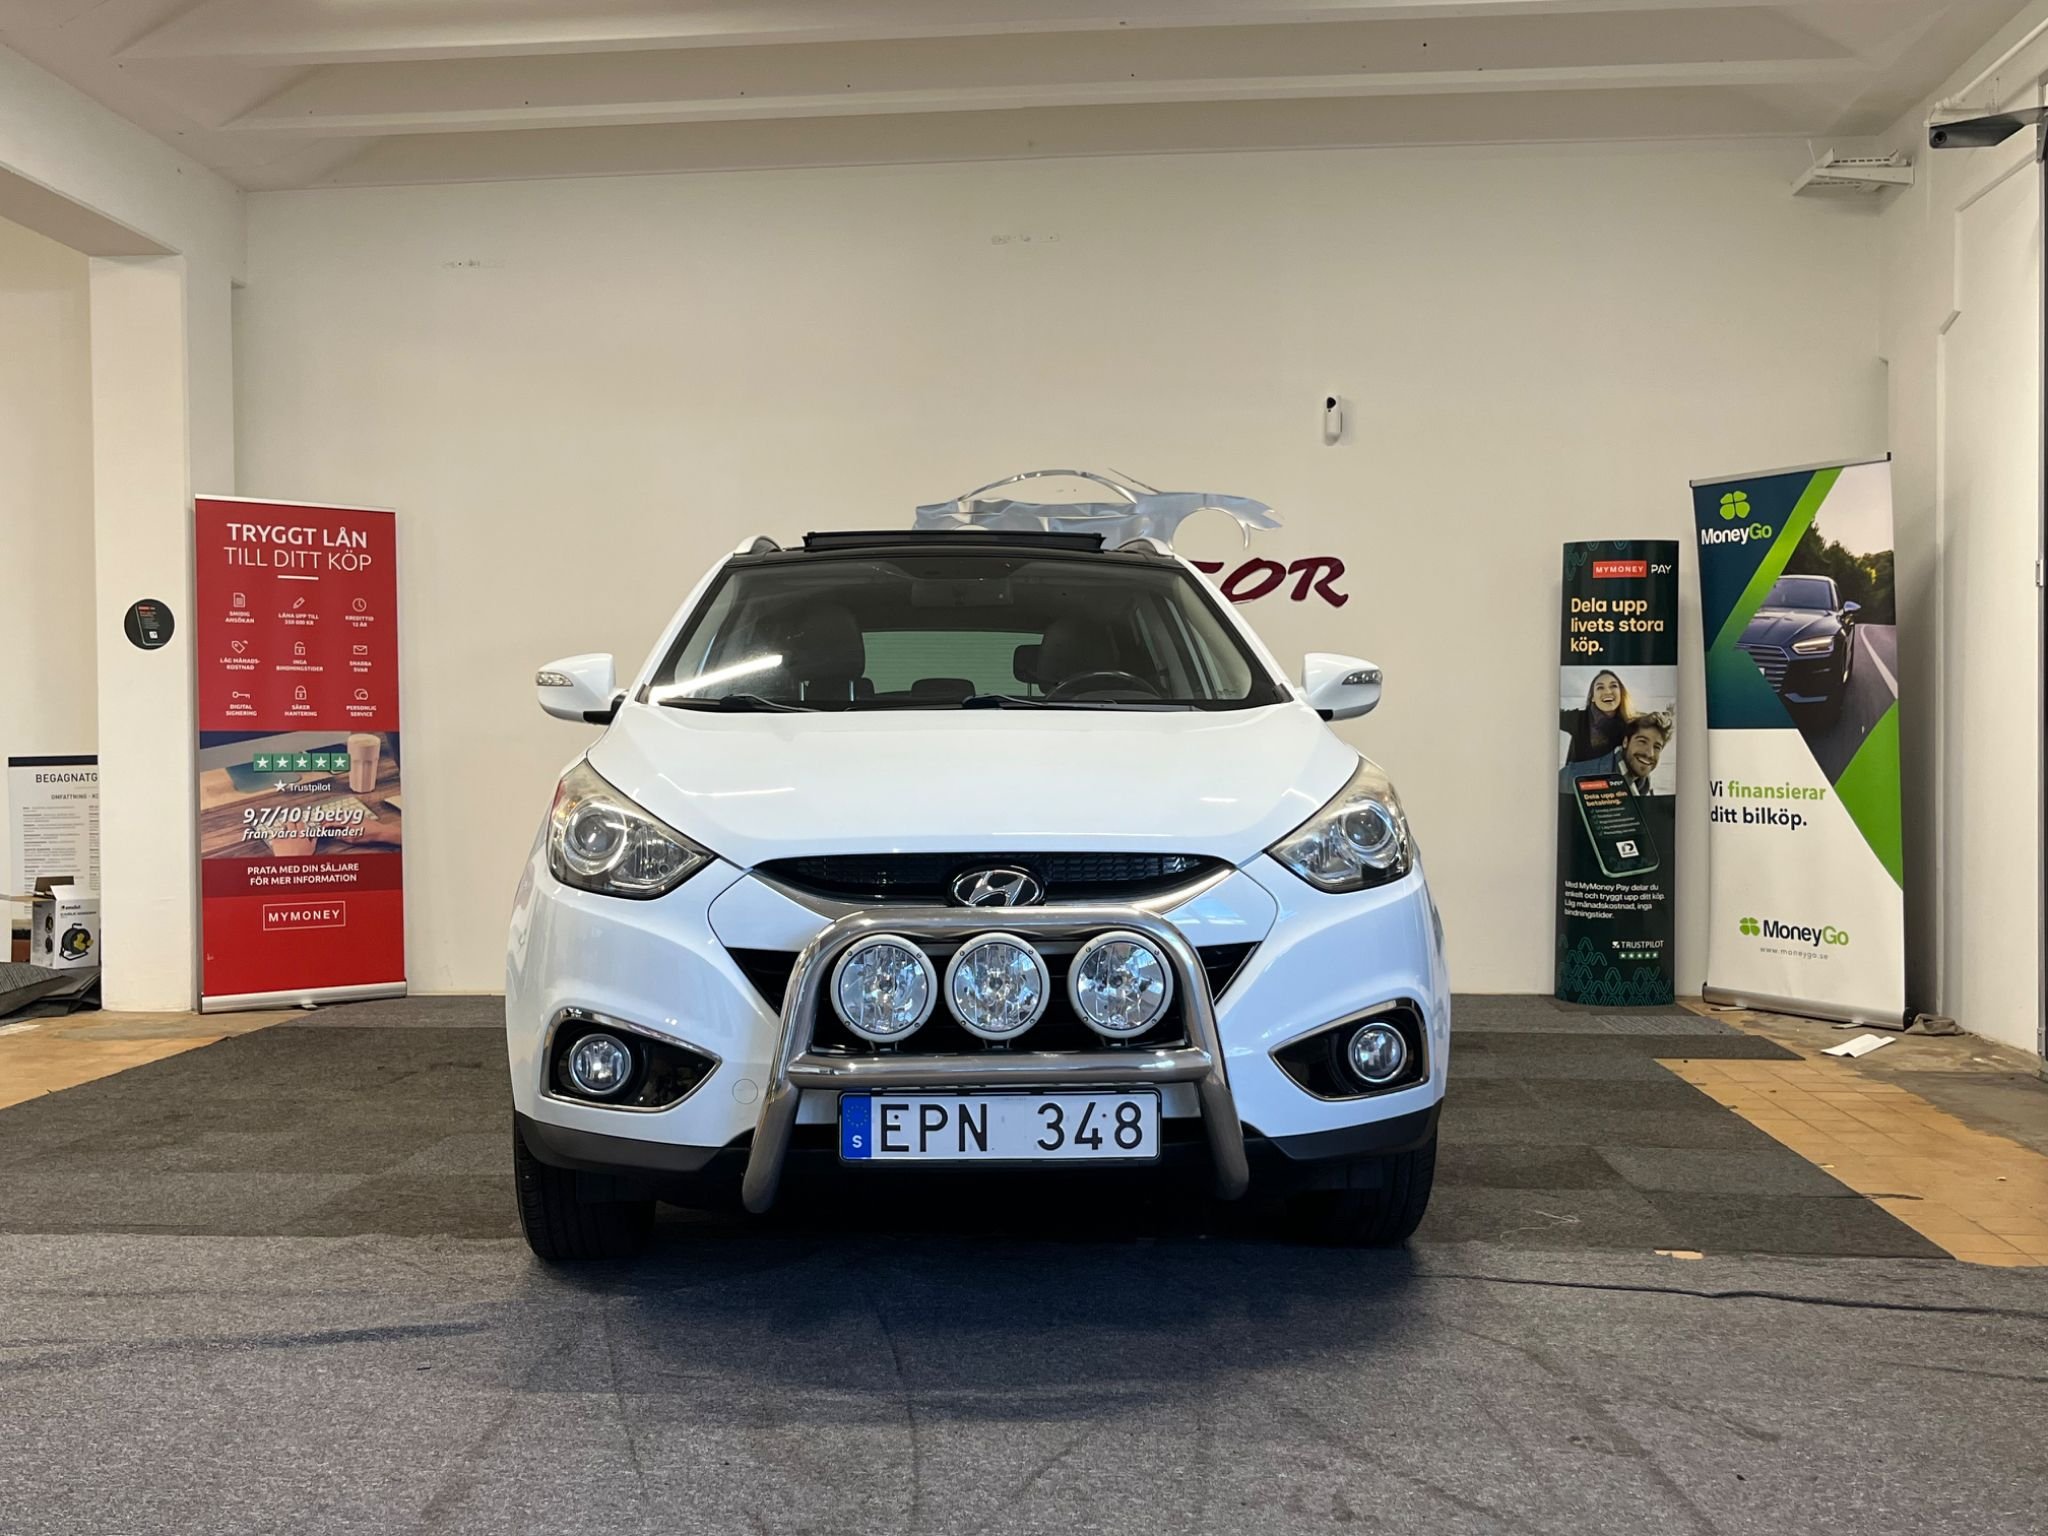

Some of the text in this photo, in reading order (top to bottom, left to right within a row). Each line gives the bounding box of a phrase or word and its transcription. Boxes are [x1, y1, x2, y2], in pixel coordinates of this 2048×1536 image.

[226, 523, 368, 548] TRYGGT LÅN
[1701, 522, 1772, 545] MoneyGo
[224, 546, 372, 572] TILL DITT KÖP
[1650, 564, 1672, 574] PAY
[1571, 598, 1648, 616] Dela upp
[1571, 617, 1664, 632] livets stora
[1571, 637, 1603, 655] köp.
[290, 783, 331, 793] Trustpilot
[1709, 780, 1826, 800] Vi finansierar
[243, 806, 364, 826] 9,7/10 i betyg
[1710, 806, 1808, 830] ditt bilköp.
[299, 827, 364, 838] slutkunder!
[247, 862, 360, 875] PRATA MED DIN SÄLJARE
[250, 874, 357, 886] FÖR MER INFORMATION
[1579, 882, 1615, 892] MyMoney
[1616, 884, 1629, 892] Pay
[1600, 893, 1623, 901] tryggt
[1637, 903, 1652, 911] inga
[268, 909, 340, 922] MYMONEY
[1763, 920, 1849, 947] MoneyGo
[1621, 940, 1664, 948] TRUSTPILOT
[1760, 947, 1828, 960] www.moneygo.se
[880, 1102, 1142, 1152] EPN 348
[852, 1135, 863, 1148] S
